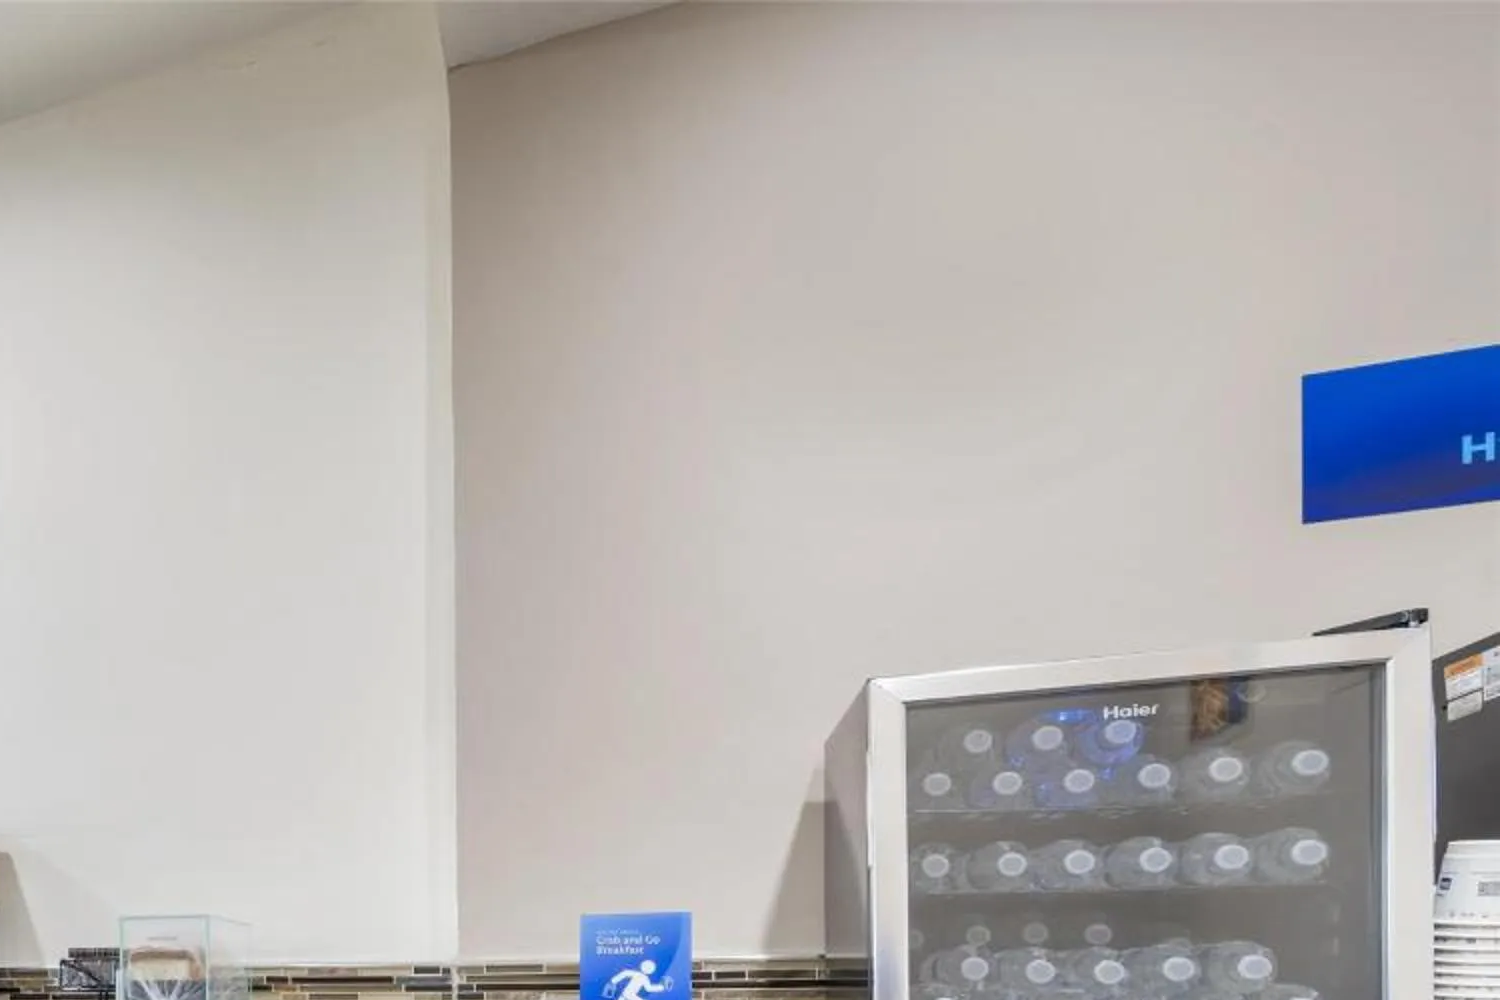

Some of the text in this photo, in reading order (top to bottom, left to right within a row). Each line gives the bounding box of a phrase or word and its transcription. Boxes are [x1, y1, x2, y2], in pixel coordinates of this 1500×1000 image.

[1461, 431, 1500, 465] H
[1103, 703, 1160, 720] Haier
[623, 934, 643, 945] and
